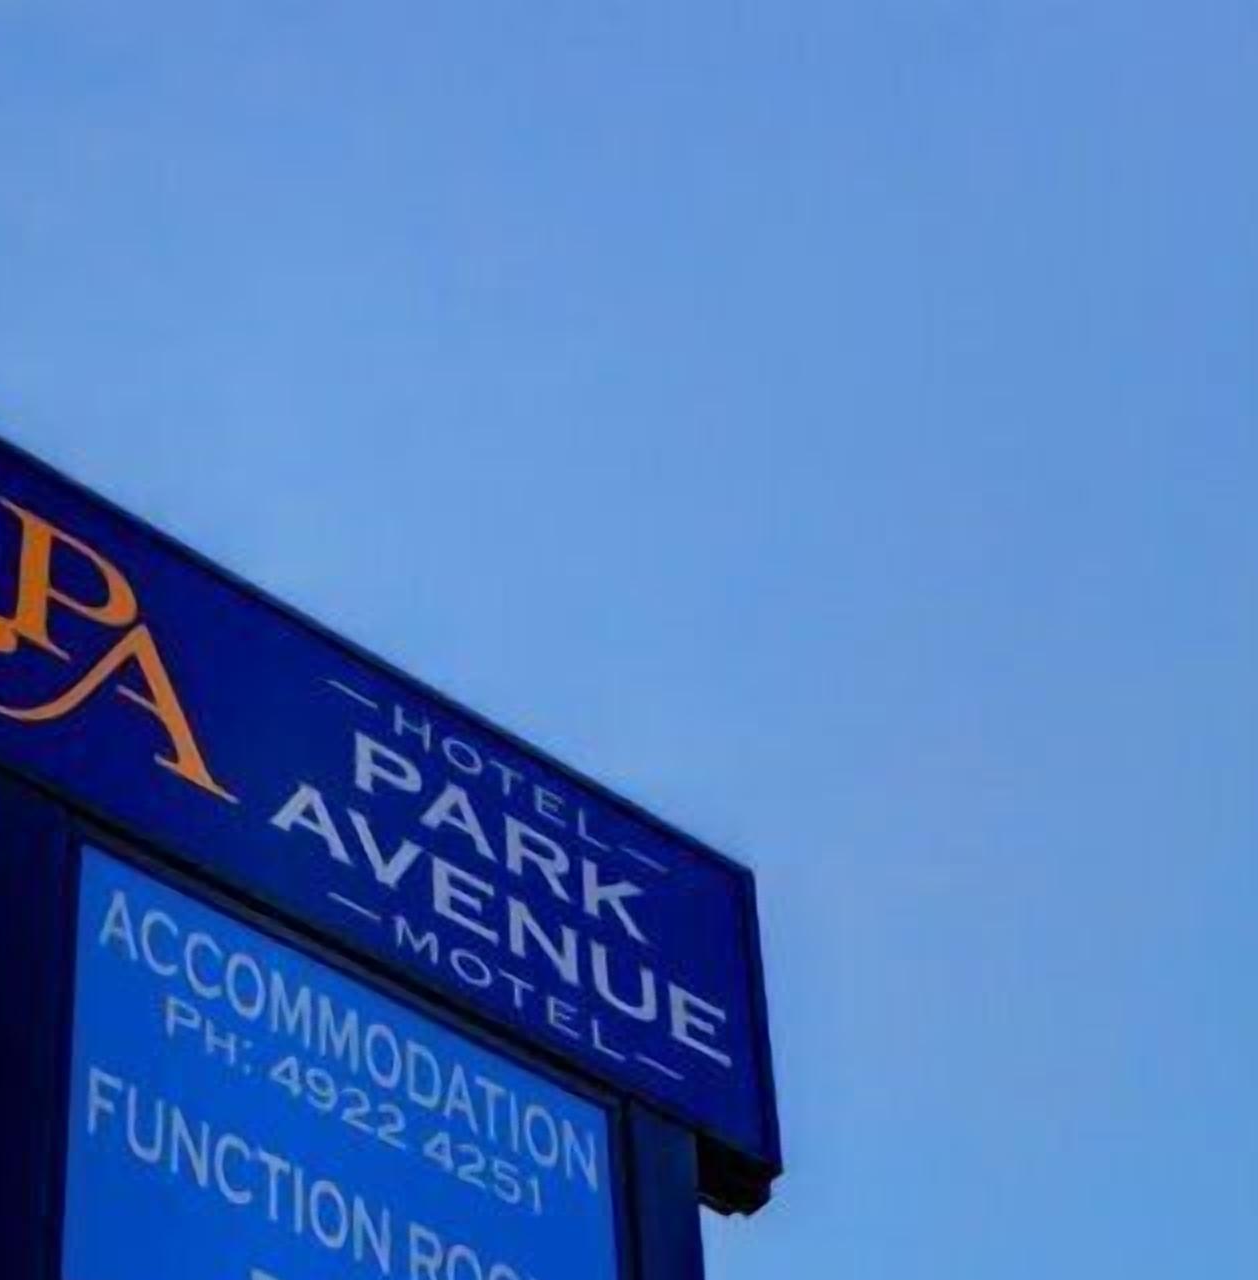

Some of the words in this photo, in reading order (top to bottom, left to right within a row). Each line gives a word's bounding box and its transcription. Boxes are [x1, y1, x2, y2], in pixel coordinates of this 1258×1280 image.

[353, 731, 650, 945] PARK
[393, 705, 610, 851] HOTEL
[269, 783, 732, 1068] AVENUE
[394, 915, 626, 1062] MOTEL
[99, 890, 599, 1192] ACCOMMODATION
[164, 996, 254, 1075] PH:
[270, 1055, 407, 1149] 4922
[424, 1131, 542, 1215] 4251
[87, 1067, 390, 1276] FUNCTION
